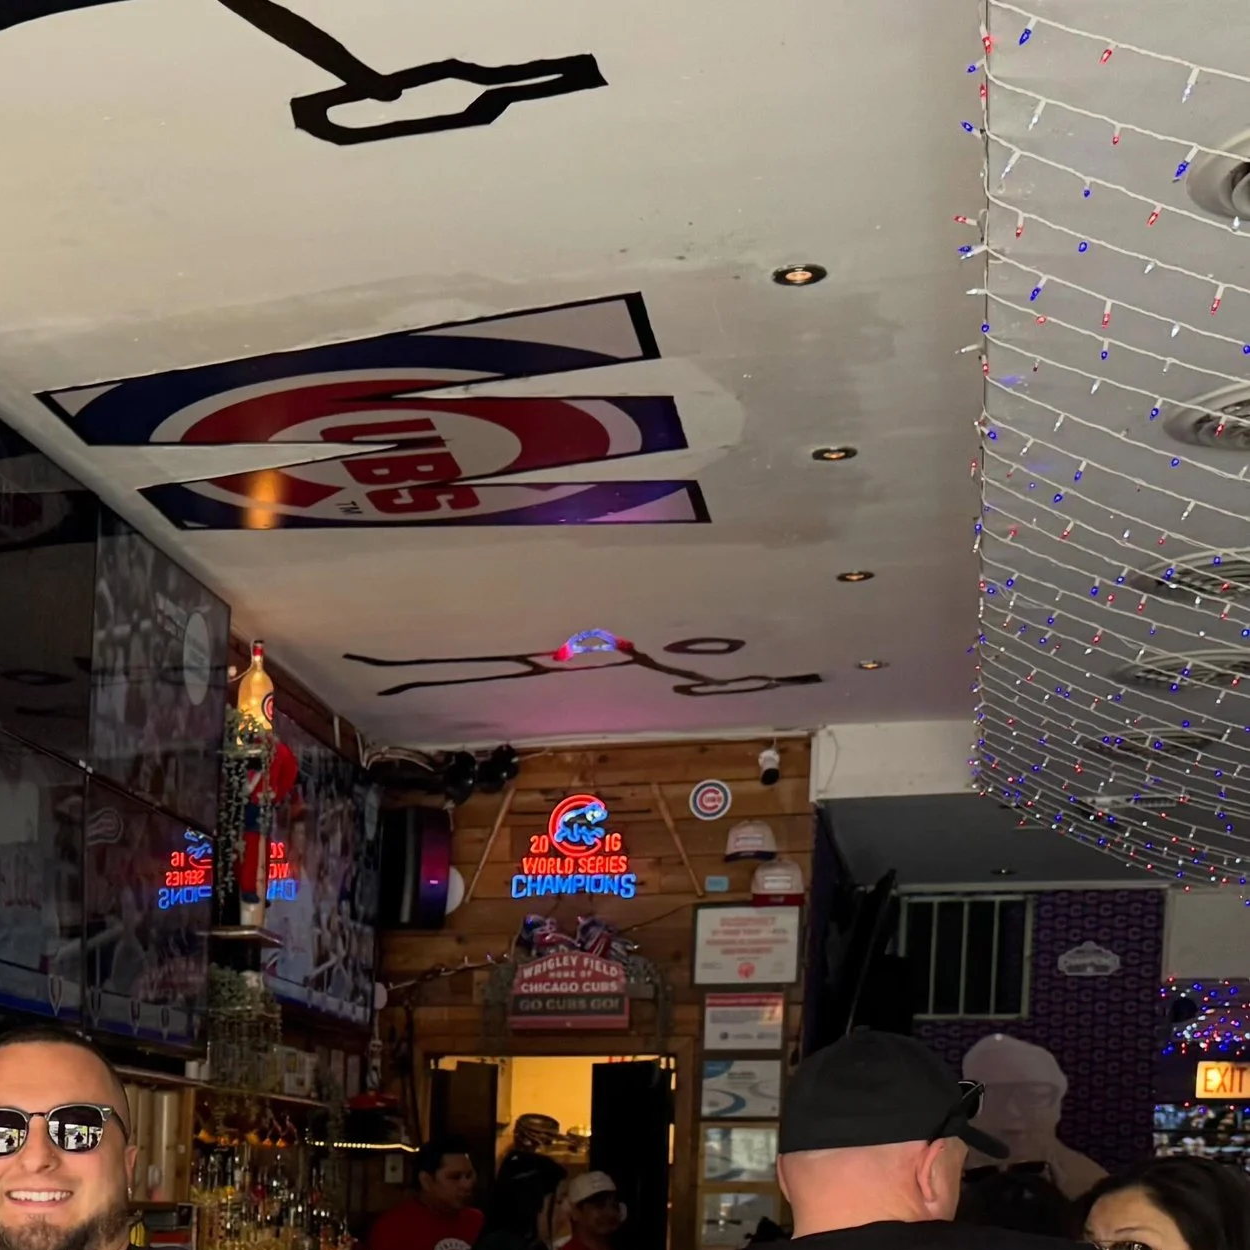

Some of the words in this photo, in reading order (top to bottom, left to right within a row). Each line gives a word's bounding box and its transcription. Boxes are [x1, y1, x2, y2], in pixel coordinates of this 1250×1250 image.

[530, 834, 549, 853] 20
[605, 832, 622, 852] 16
[522, 857, 574, 874] WORLD
[578, 856, 628, 873] SERIES
[511, 874, 637, 898] CHAMPIONS
[522, 956, 578, 978] WRIGLEY
[583, 956, 618, 976] FIELD
[521, 982, 578, 993] CHICAGO
[582, 982, 618, 992] CUBS
[519, 999, 542, 1011] GO
[546, 998, 587, 1010] CUBS
[1203, 1067, 1249, 1094] EXIT
